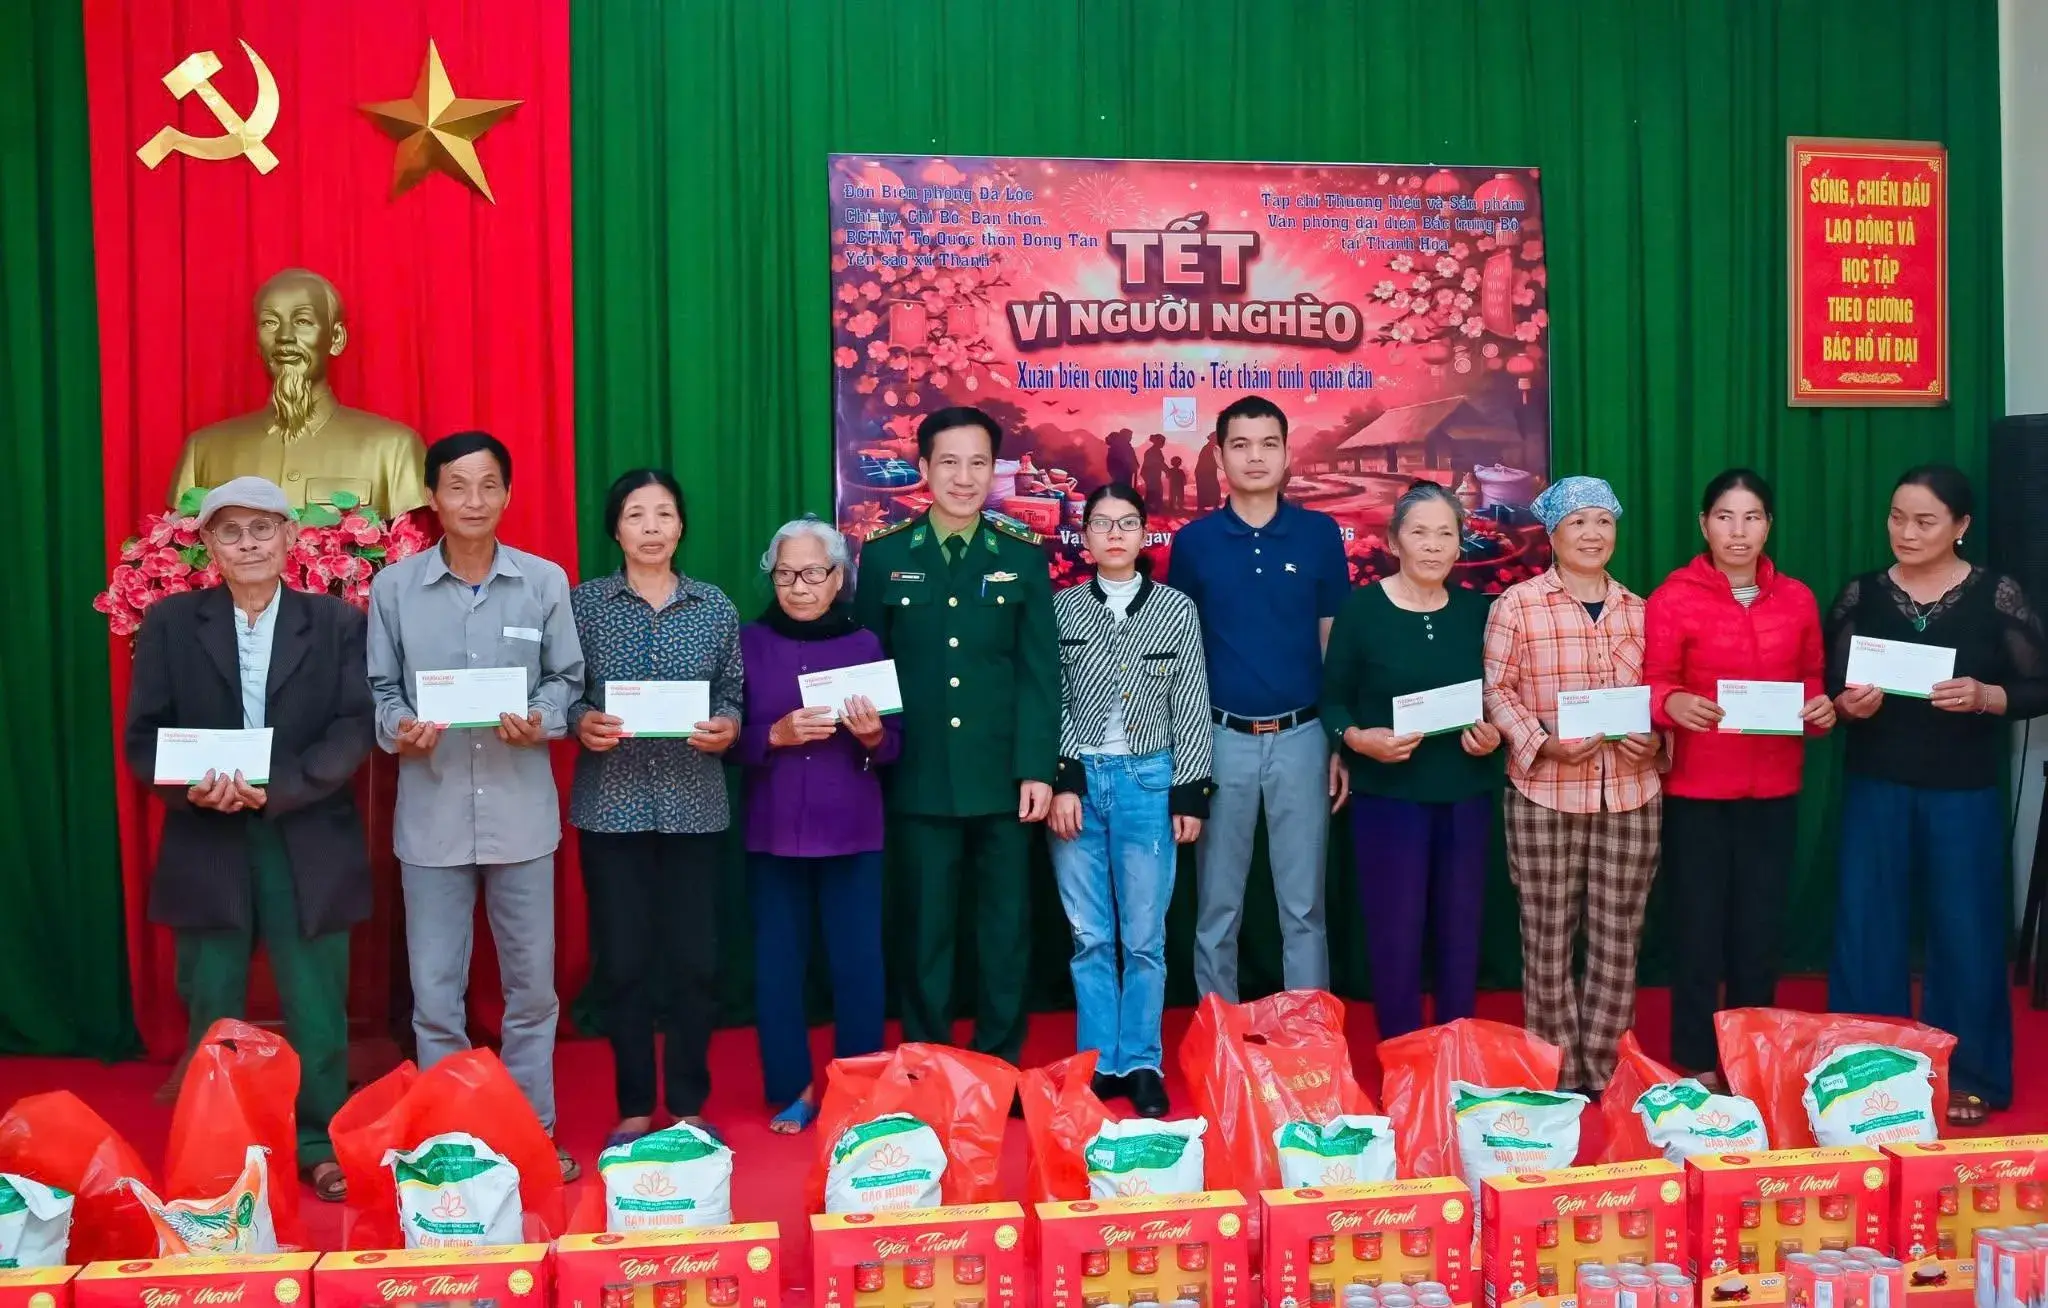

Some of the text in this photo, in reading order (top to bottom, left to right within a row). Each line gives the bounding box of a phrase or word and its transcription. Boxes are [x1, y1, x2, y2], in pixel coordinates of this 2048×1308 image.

[1810, 170, 1931, 208] SỐNG, CHIẾN ĐẤU
[1826, 215, 1916, 250] LAO ĐỘNG VÀ
[1110, 213, 1256, 287] TẾT
[1842, 254, 1900, 289] HỌC TẬP
[1011, 293, 1357, 342] VÌ NGƯỜI NGHÈO
[1828, 296, 1913, 324] THEO GƯƠNG
[1823, 328, 1918, 367] BÁC HỒ VĨ ĐẠI
[1017, 361, 1053, 389] Xuân
[1059, 362, 1090, 389] biên
[1095, 367, 1138, 394] cương
[1143, 362, 1164, 389] hải
[1170, 362, 1195, 389] đảo
[1210, 360, 1233, 389] Tết
[1238, 360, 1272, 389] thắm
[1278, 362, 1304, 389] tình
[1310, 362, 1343, 394] quân
[1348, 363, 1373, 389] dân
[1756, 1171, 1840, 1198] Yến Thanh
[1553, 1187, 1638, 1216] Yến Thanh
[1099, 1218, 1193, 1247] Yến Thanh
[1326, 1204, 1418, 1232] Yến Thanh
[873, 1230, 969, 1259] Yến Thanh
[619, 1251, 720, 1281] Yến Thanh
[186, 1281, 248, 1305] Thanh
[377, 1273, 480, 1301] Yến Thanh
